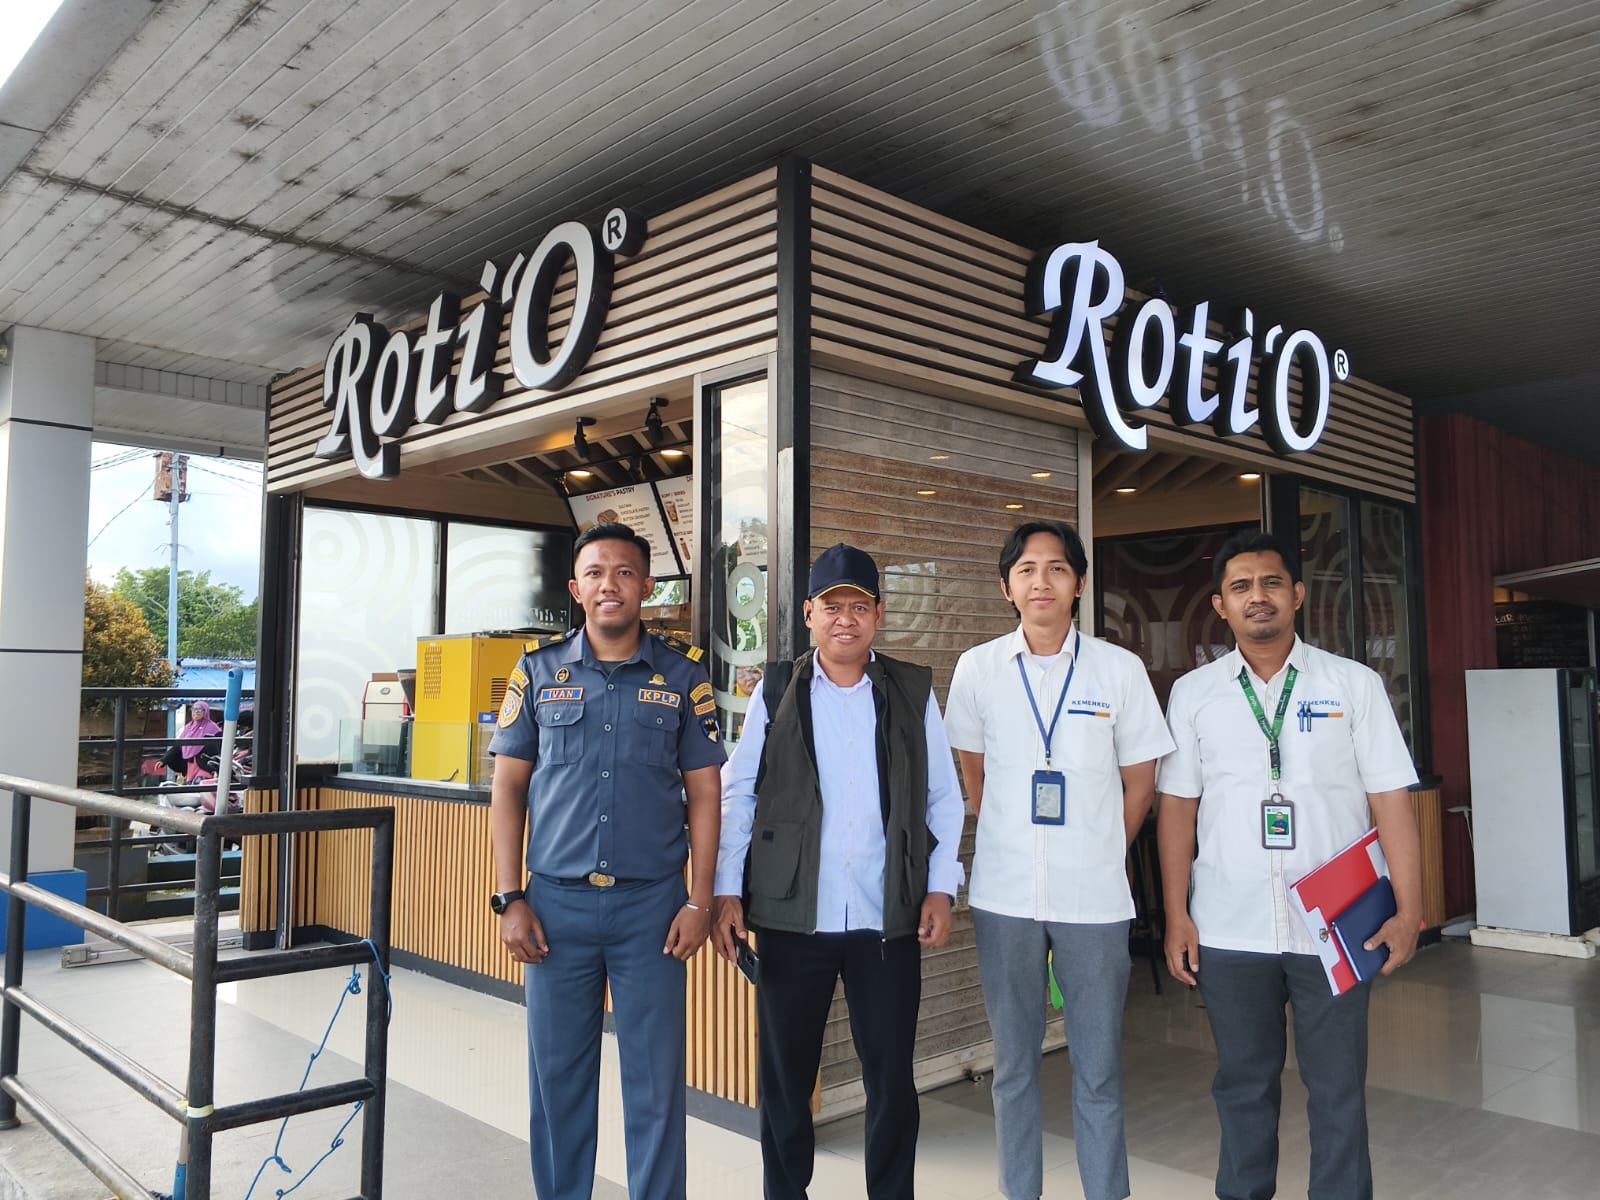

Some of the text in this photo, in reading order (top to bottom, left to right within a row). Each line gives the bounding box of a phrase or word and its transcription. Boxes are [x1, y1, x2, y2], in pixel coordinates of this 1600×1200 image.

[549, 689, 573, 698] IVAN
[644, 691, 676, 703] KPLP
[1071, 699, 1110, 709] KEMENKEU
